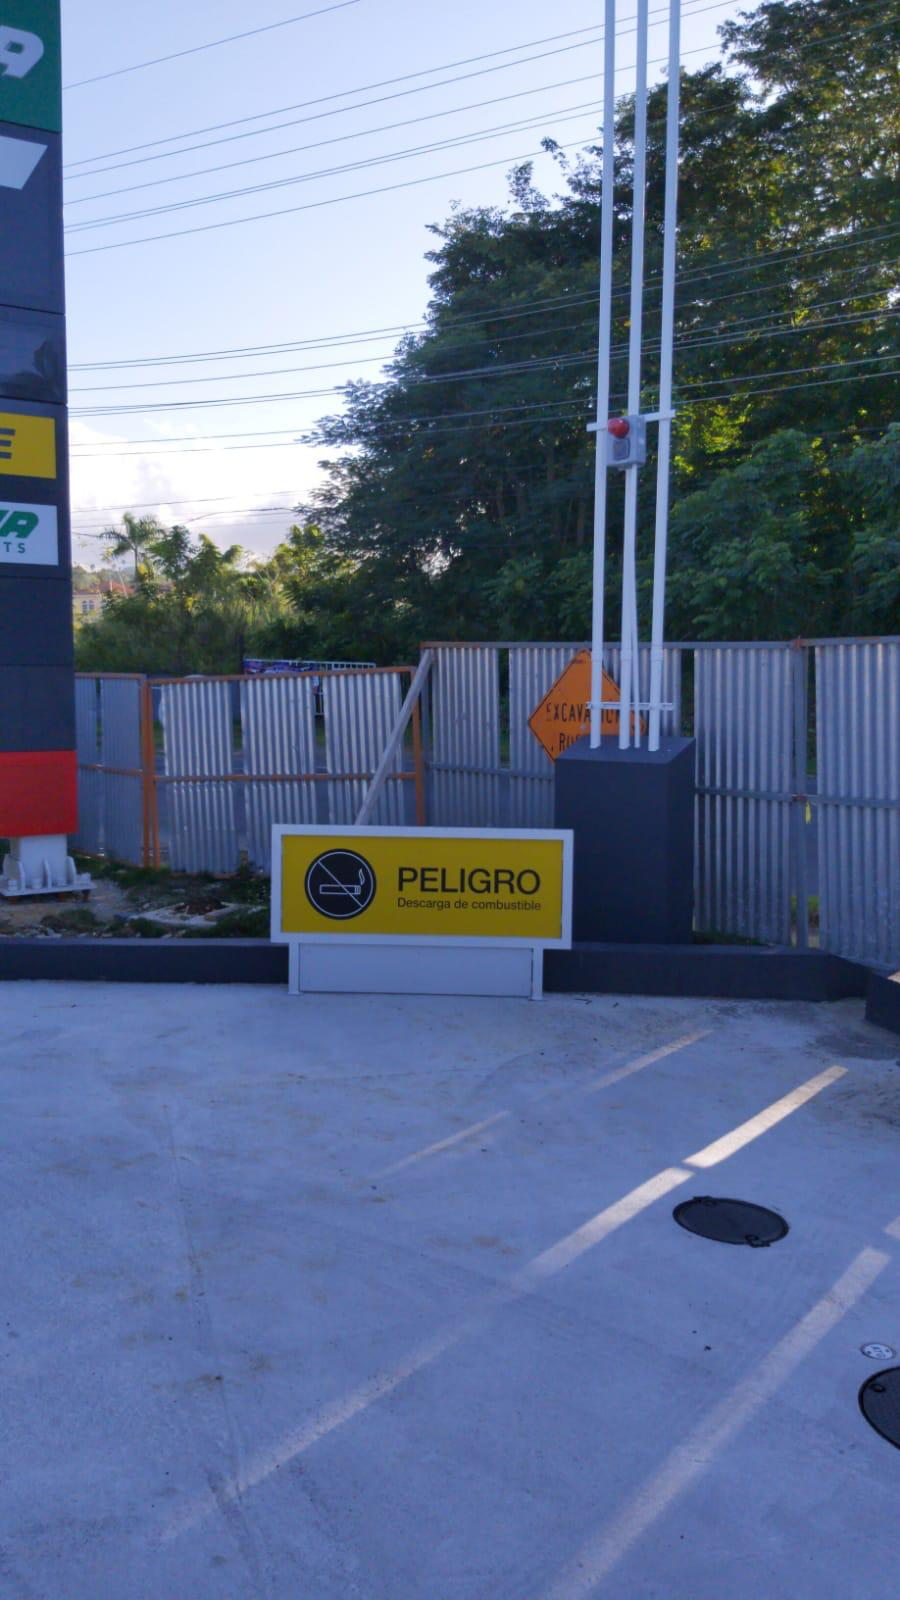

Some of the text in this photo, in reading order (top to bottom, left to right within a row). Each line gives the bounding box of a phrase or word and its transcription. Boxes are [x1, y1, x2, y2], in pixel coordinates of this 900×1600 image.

[398, 867, 541, 895] PELIGRO
[397, 897, 541, 911] Descarga de combustible
